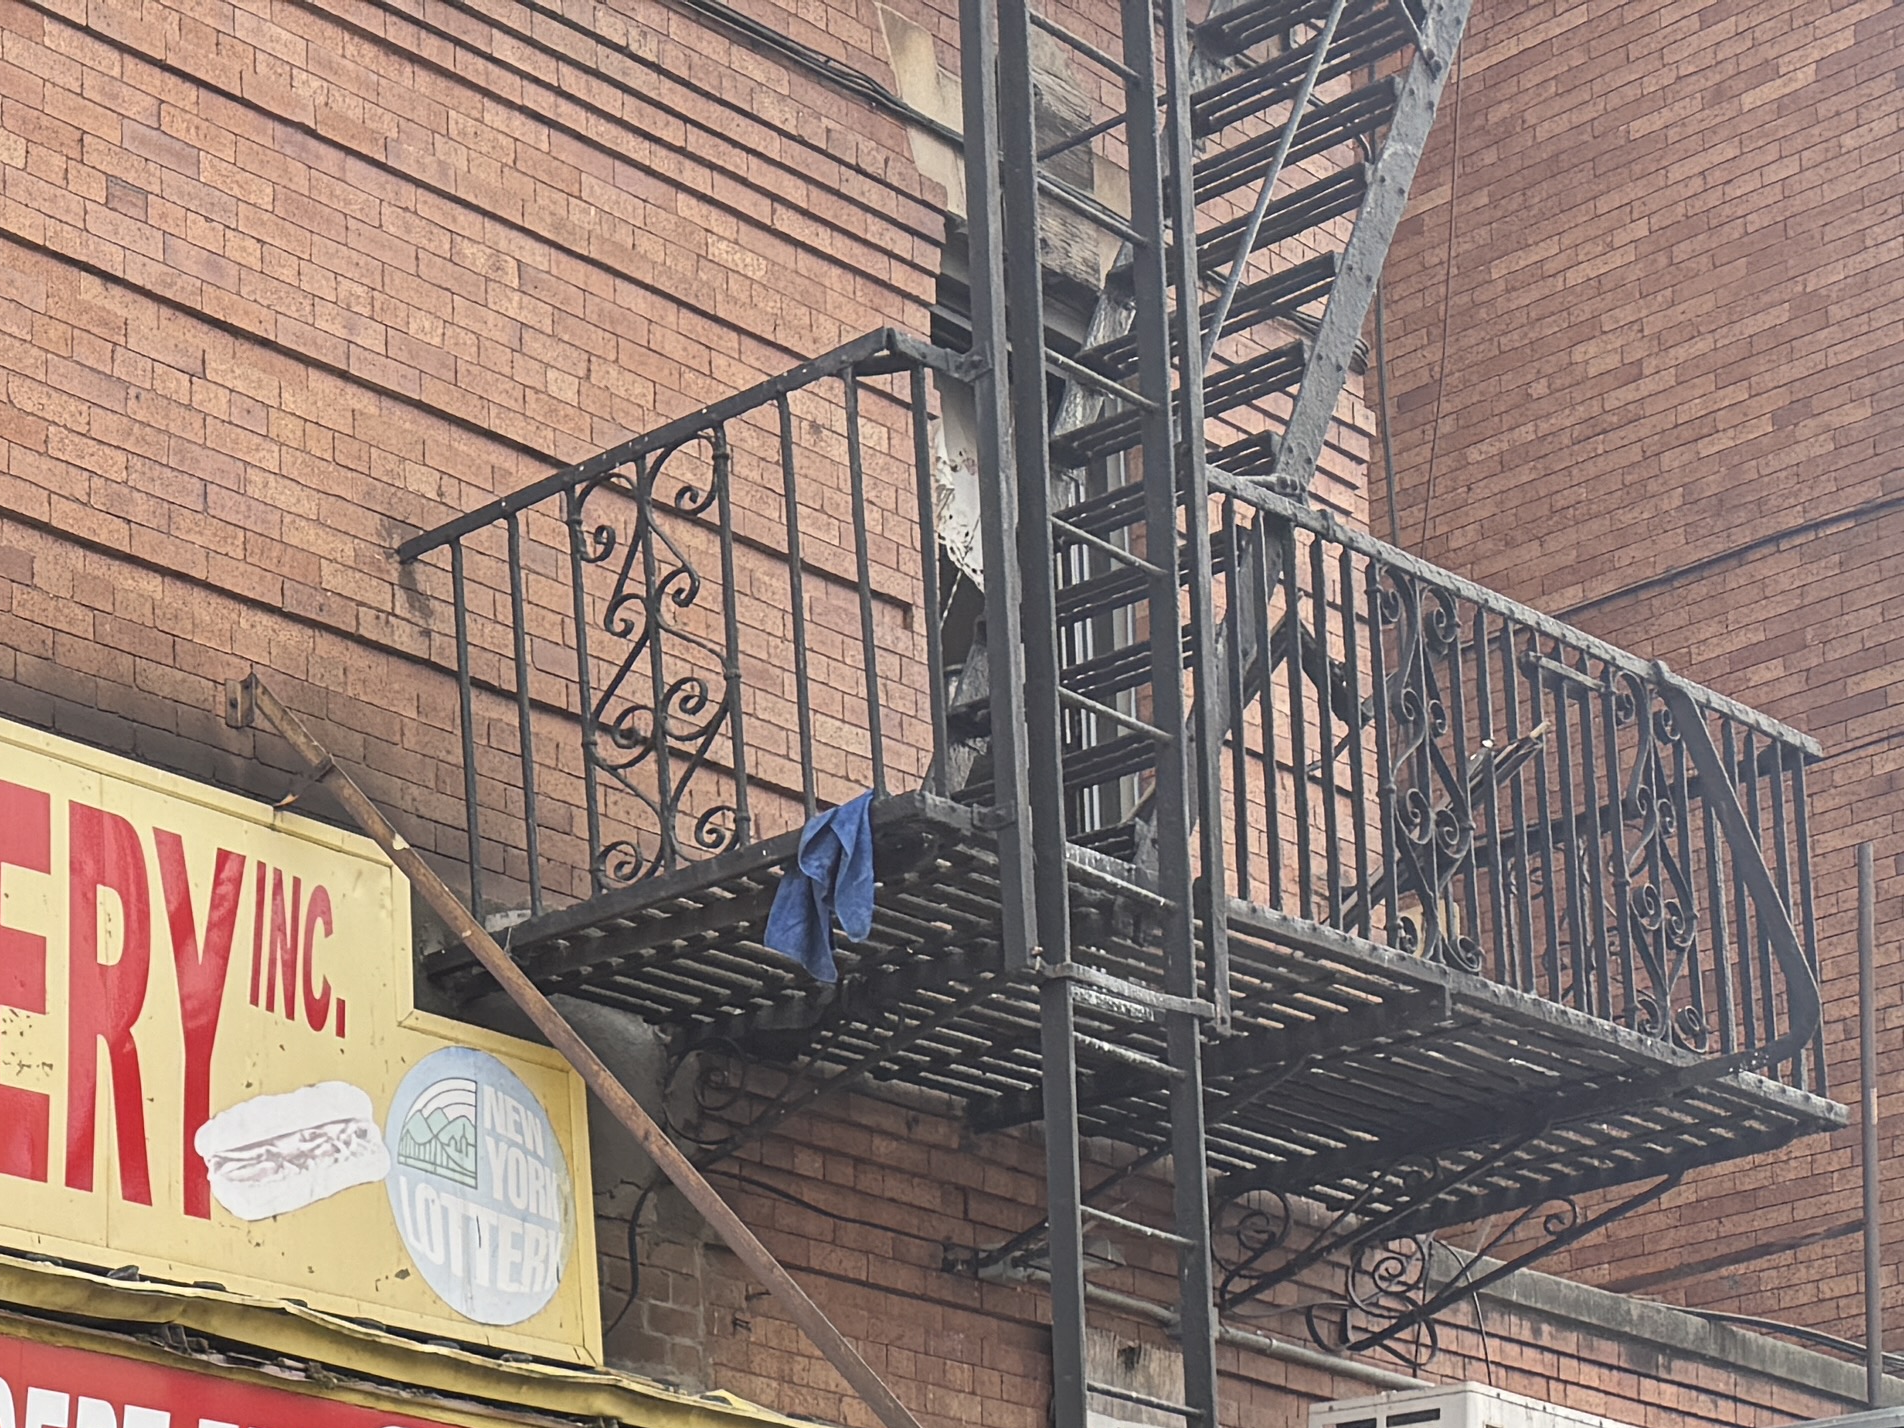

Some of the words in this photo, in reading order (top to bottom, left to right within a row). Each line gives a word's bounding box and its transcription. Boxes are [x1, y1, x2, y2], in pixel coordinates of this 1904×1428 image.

[249, 859, 348, 1040] INC.
[483, 1085, 545, 1158] NEW
[485, 1136, 570, 1222] YORK
[399, 1176, 566, 1294] LOTTERY
